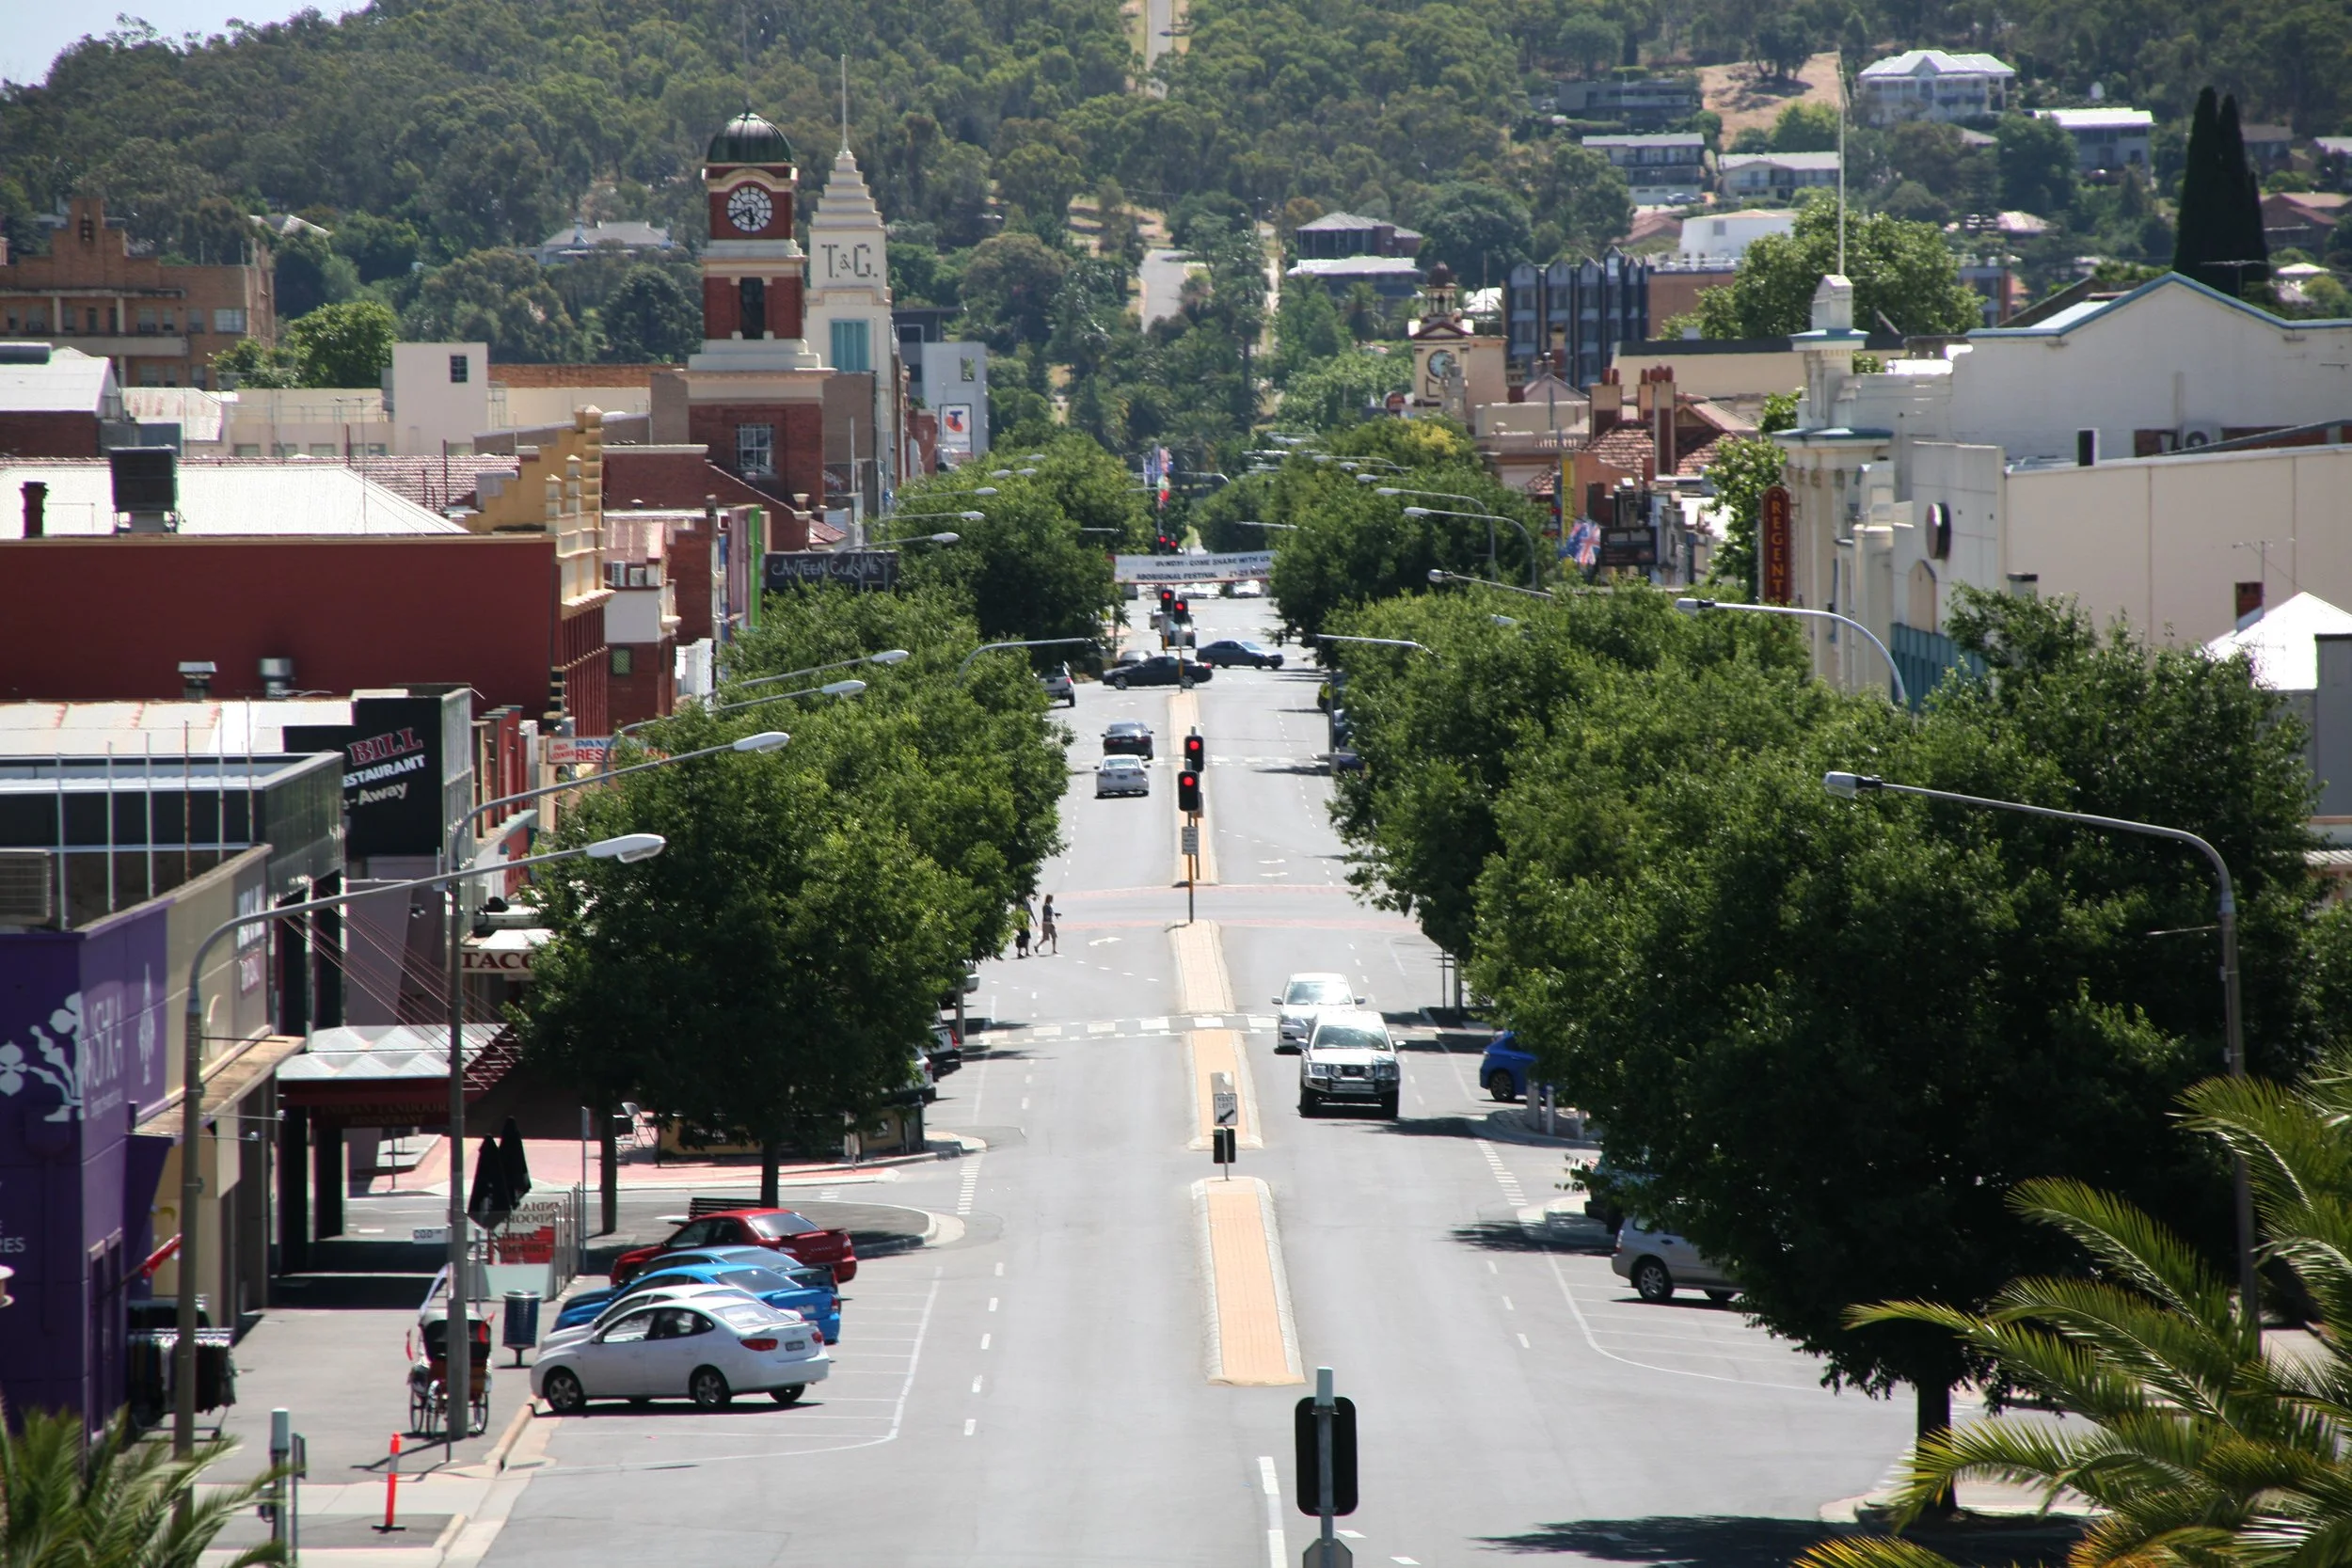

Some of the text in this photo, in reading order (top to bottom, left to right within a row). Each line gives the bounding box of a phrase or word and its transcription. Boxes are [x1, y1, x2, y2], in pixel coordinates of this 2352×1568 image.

[1771, 499, 1786, 593] REGENT
[346, 727, 423, 767] BILL
[342, 754, 425, 788] ESTAURANT
[377, 1101, 449, 1114] TANDOOR
